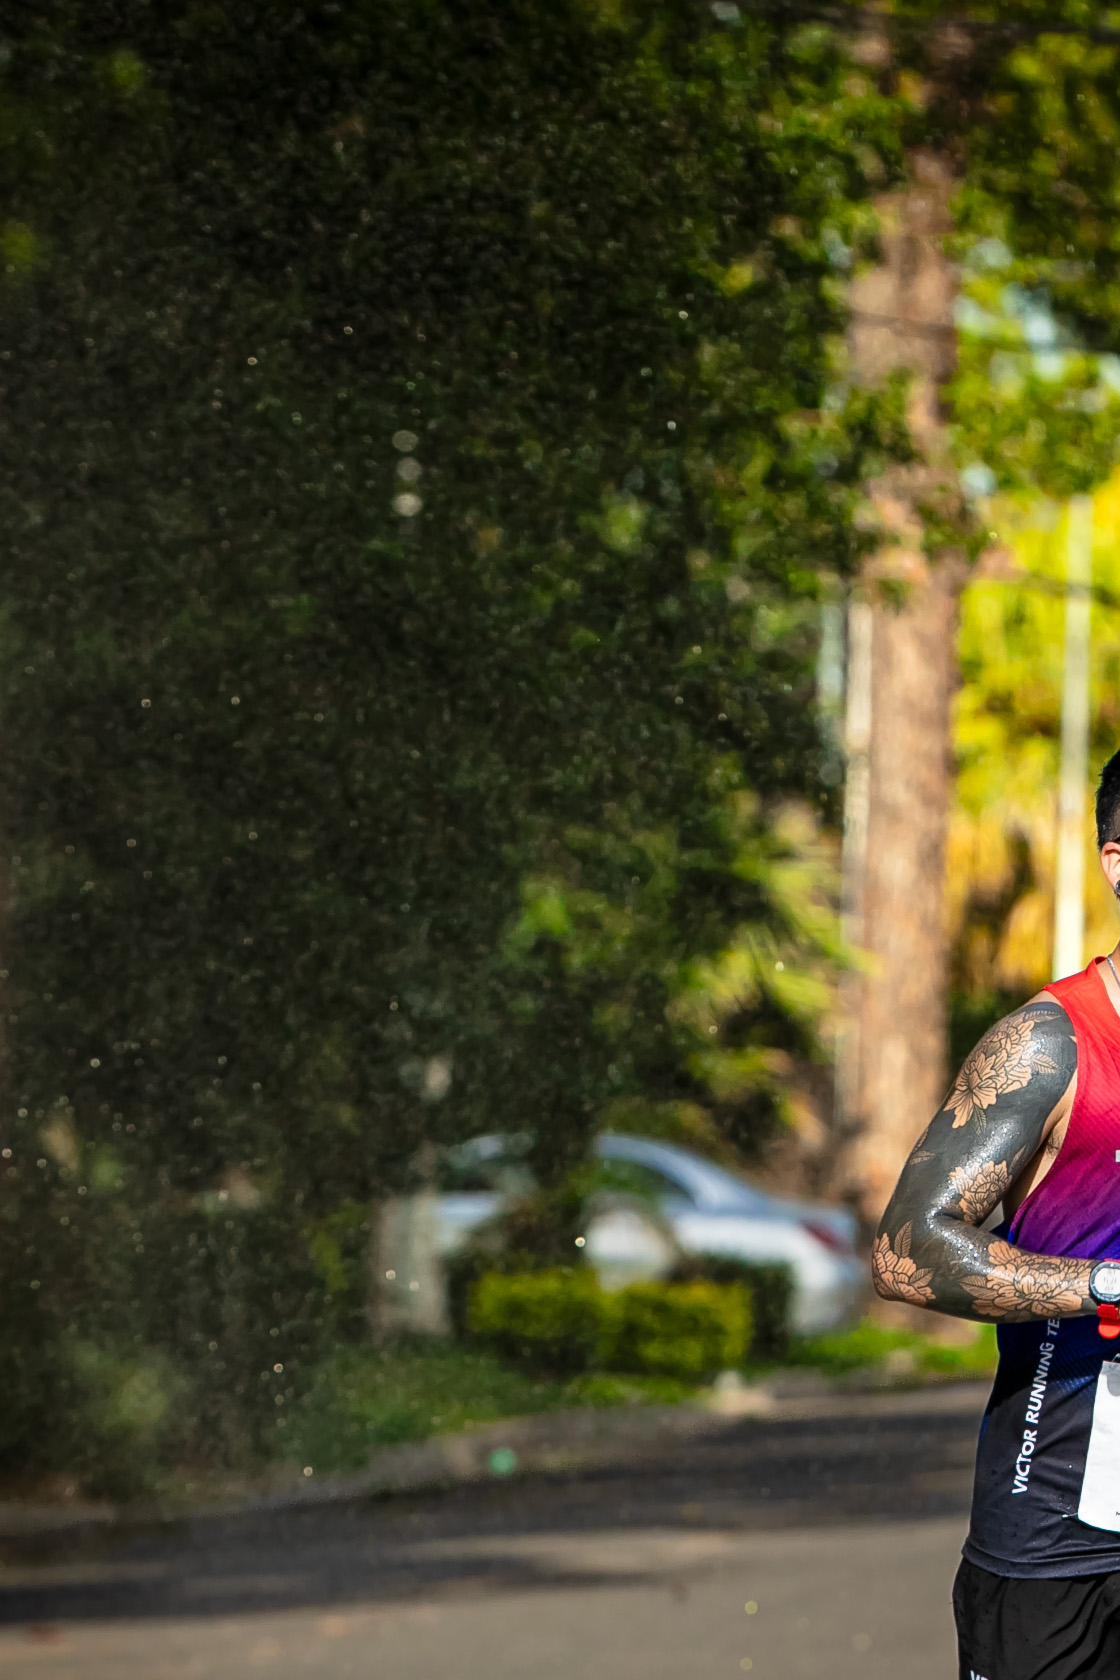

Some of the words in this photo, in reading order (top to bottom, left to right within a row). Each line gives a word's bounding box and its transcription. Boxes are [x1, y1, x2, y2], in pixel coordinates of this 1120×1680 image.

[1011, 1429, 1038, 1495] VICTOR
[1025, 1341, 1055, 1425] RUNNING
[1046, 1317, 1061, 1337] TE
